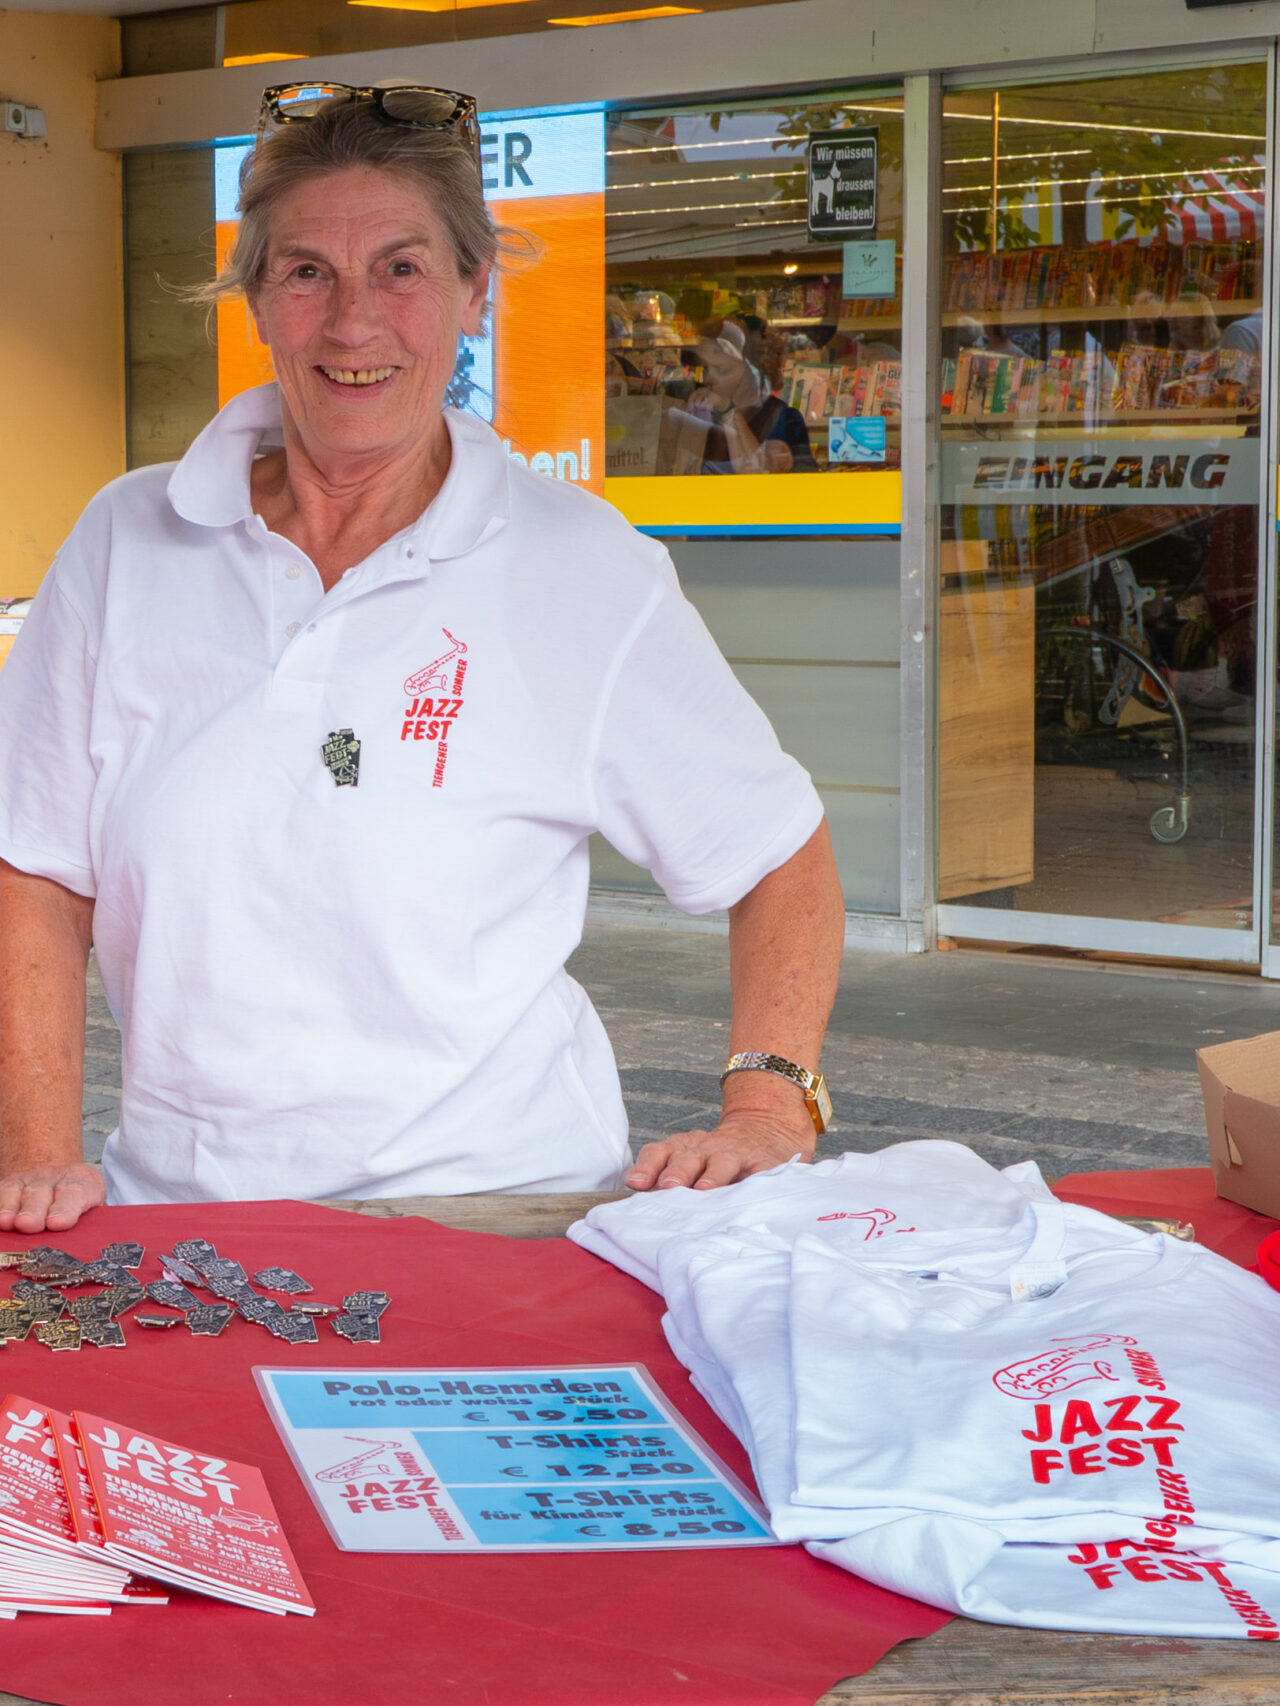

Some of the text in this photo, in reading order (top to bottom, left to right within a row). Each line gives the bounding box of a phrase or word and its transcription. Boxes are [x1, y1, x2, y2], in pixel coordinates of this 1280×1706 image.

[816, 145, 874, 161] Wir müssen
[836, 178, 874, 192] draussen
[835, 205, 873, 221] bleiben!
[973, 454, 1231, 489] EINGANG
[452, 659, 467, 697] SOMMER
[405, 698, 464, 718] JAZZ
[400, 720, 453, 740] FEST
[432, 741, 448, 788] TIENGENER
[322, 1378, 622, 1397] Polo-Hemden
[349, 1392, 629, 1407] rot oder weiss Stück
[463, 1408, 648, 1424] € 19,50
[1020, 1395, 1185, 1444] JAZZ
[486, 1434, 668, 1450] T-Shirts
[89, 1427, 231, 1481] JAZZ
[393, 1451, 425, 1477] SOMMER
[604, 1448, 677, 1459] Stück
[1030, 1436, 1179, 1484] FEST
[102, 1447, 241, 1505] FEST
[500, 1463, 695, 1479] € 12,50
[103, 1471, 204, 1516] TIENGENER
[108, 1490, 121, 1498] in
[339, 1477, 440, 1498] JAZZ
[106, 1481, 215, 1529] SOMMER
[347, 1492, 439, 1514] FEST
[524, 1489, 717, 1508] T-Shirts
[480, 1506, 727, 1521] für Kinder Stück
[117, 1505, 172, 1532] Freitag
[217, 1543, 244, 1555] Juli
[247, 1551, 287, 1567] 2026
[580, 1522, 748, 1539] € 8,50
[108, 1508, 175, 1539] Samstag
[220, 1550, 246, 1562] Juli
[250, 1558, 291, 1575] 2026
[114, 1530, 182, 1559] Tiengen
[193, 1562, 301, 1599] EINTRITT FREI
[1084, 1556, 1233, 1590] FEST
